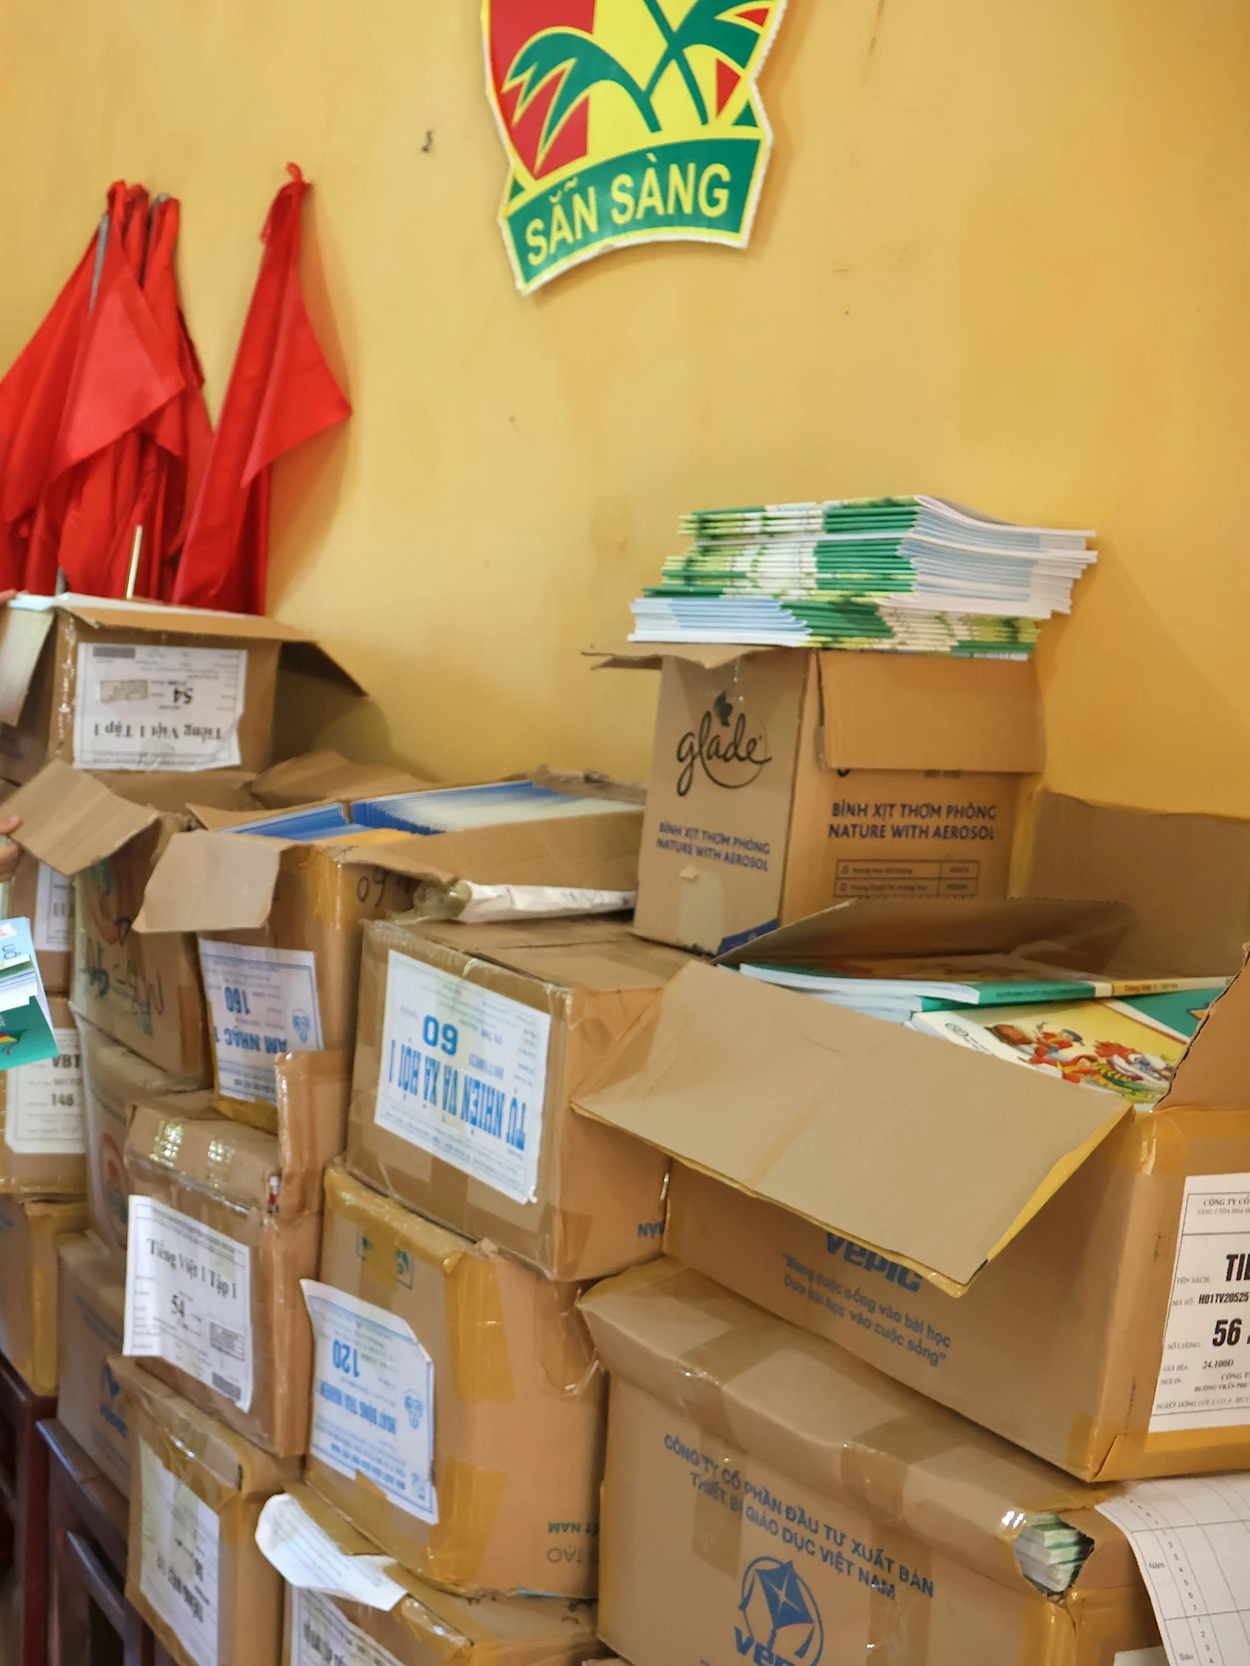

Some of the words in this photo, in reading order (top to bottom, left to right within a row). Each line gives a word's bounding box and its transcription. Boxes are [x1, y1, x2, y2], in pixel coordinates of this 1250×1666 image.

[525, 177, 598, 266] SẴN
[610, 152, 731, 225] SÀNG
[172, 687, 195, 705] 54
[93, 723, 100, 737] 1
[104, 719, 133, 739] Tập
[140, 724, 146, 738] 1
[151, 721, 180, 739] Việt
[183, 723, 223, 744] Tiếng
[676, 709, 772, 796] glade
[831, 799, 869, 817] BÌNH
[872, 802, 896, 821] XỊT
[899, 802, 942, 819] THƠM
[945, 801, 998, 821] PHÒNG
[658, 820, 683, 835] BÌNH
[701, 830, 731, 846] THƠM
[732, 835, 770, 855] PHÒNG
[828, 823, 887, 839] NATURE
[890, 824, 930, 840] WITH
[932, 824, 994, 840] AEROSOL
[655, 837, 693, 855] NATURE
[695, 845, 722, 861] WITH
[722, 851, 768, 872] AEROSOL
[223, 985, 252, 1015] 160
[422, 1015, 459, 1056] 60
[1203, 1197, 1225, 1206] CÔNG
[147, 1237, 178, 1271] Tiếng
[178, 1253, 199, 1279] Việt
[208, 1269, 229, 1298] Tập
[231, 1281, 237, 1300] 1
[844, 1287, 876, 1313] sống
[878, 1303, 902, 1323] vào
[904, 1313, 924, 1333] bài
[926, 1324, 951, 1348] học
[849, 1310, 872, 1329] vào
[874, 1323, 905, 1346] cuộc
[1212, 1318, 1243, 1347] 56
[332, 1339, 361, 1378] 120
[664, 1433, 701, 1467] CÔNG
[701, 1453, 720, 1477] TY
[721, 1467, 742, 1491] CỔ
[744, 1481, 783, 1515] PHẦN
[784, 1504, 820, 1535] ĐẦU
[823, 1523, 848, 1547] TƯ
[851, 1538, 896, 1575] XUẤT
[899, 1562, 935, 1598] BẢN
[547, 1521, 582, 1534] NAM
[690, 1470, 728, 1504] THIẾT
[745, 1505, 780, 1537] GIÁO
[781, 1526, 817, 1557] DỤC
[819, 1544, 856, 1577] VIỆT
[857, 1566, 897, 1601] NAM
[1168, 1541, 1174, 1549] 2
[1188, 1591, 1194, 1599] 6
[1192, 1604, 1198, 1612] 7
[1200, 1631, 1206, 1639] 2
[1204, 1643, 1210, 1652] 3
[1208, 1657, 1215, 1665] 4
